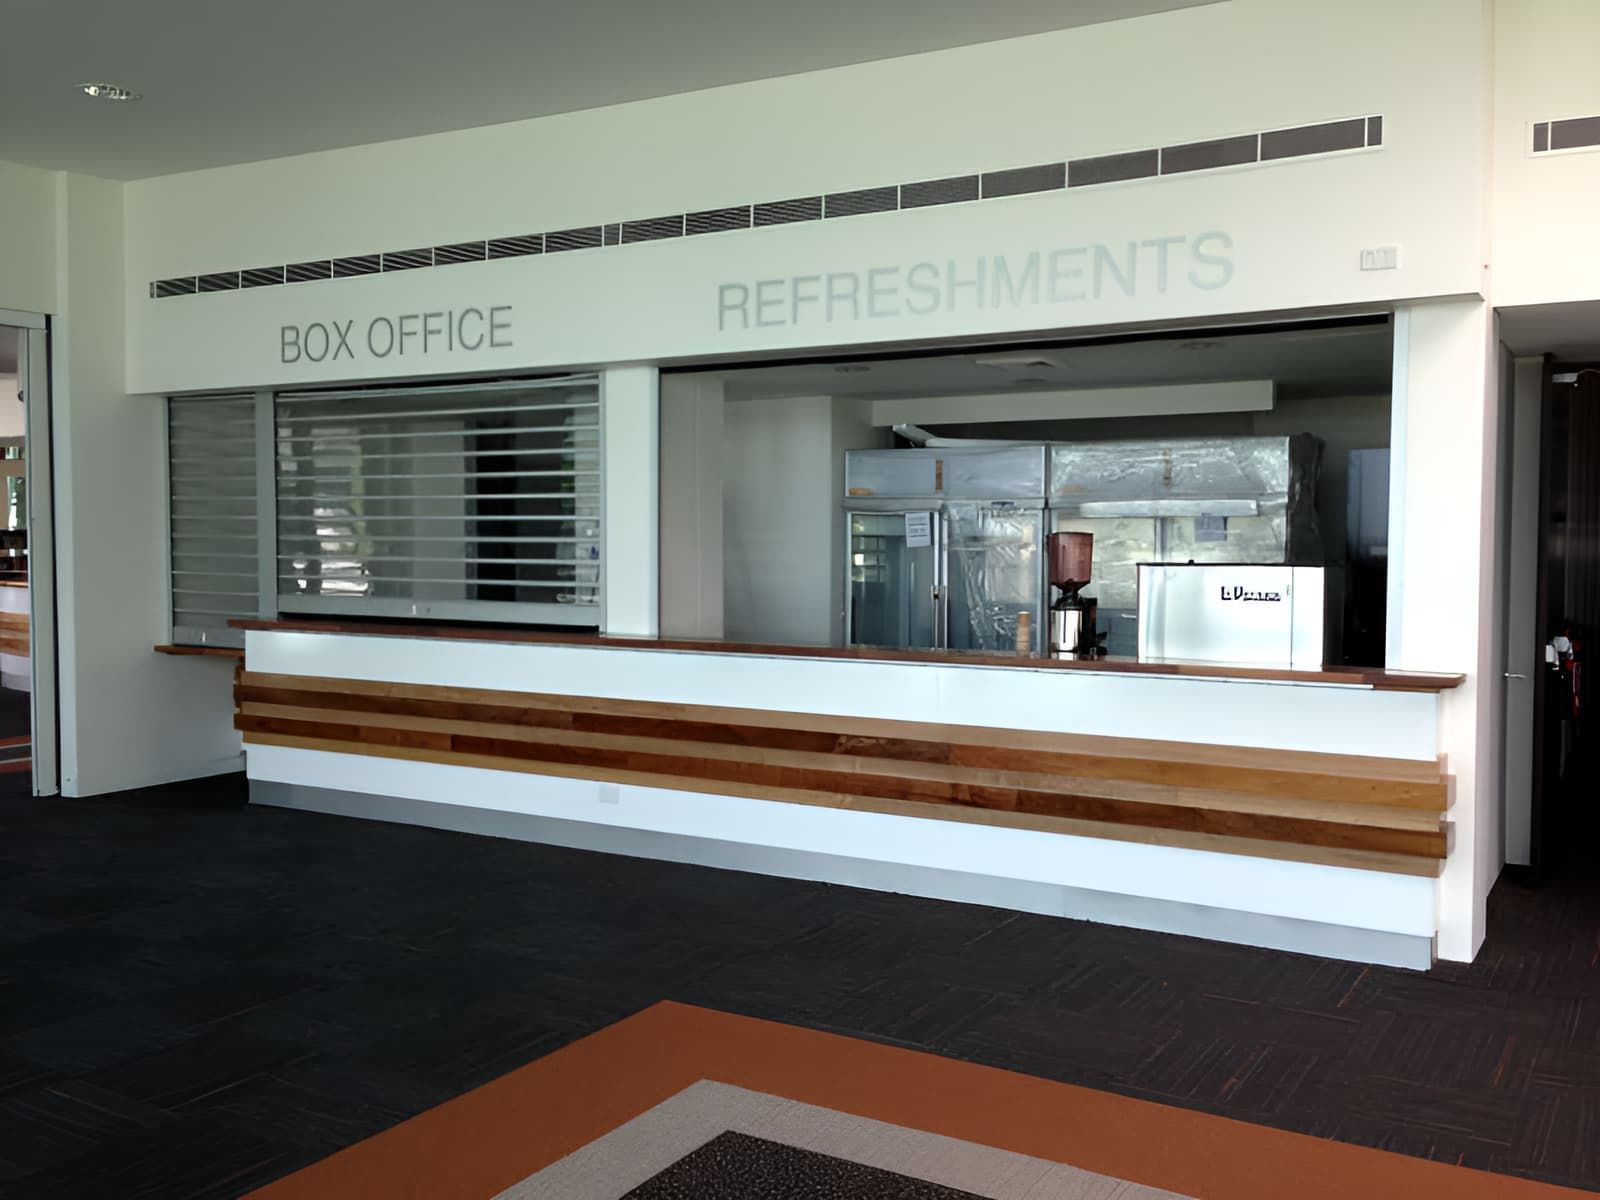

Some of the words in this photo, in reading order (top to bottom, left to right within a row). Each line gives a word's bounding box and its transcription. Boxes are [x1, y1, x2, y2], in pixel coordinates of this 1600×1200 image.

[717, 230, 1235, 331] REFRESHMENTS
[280, 319, 354, 364] BOX
[367, 305, 513, 359] OFFICE
